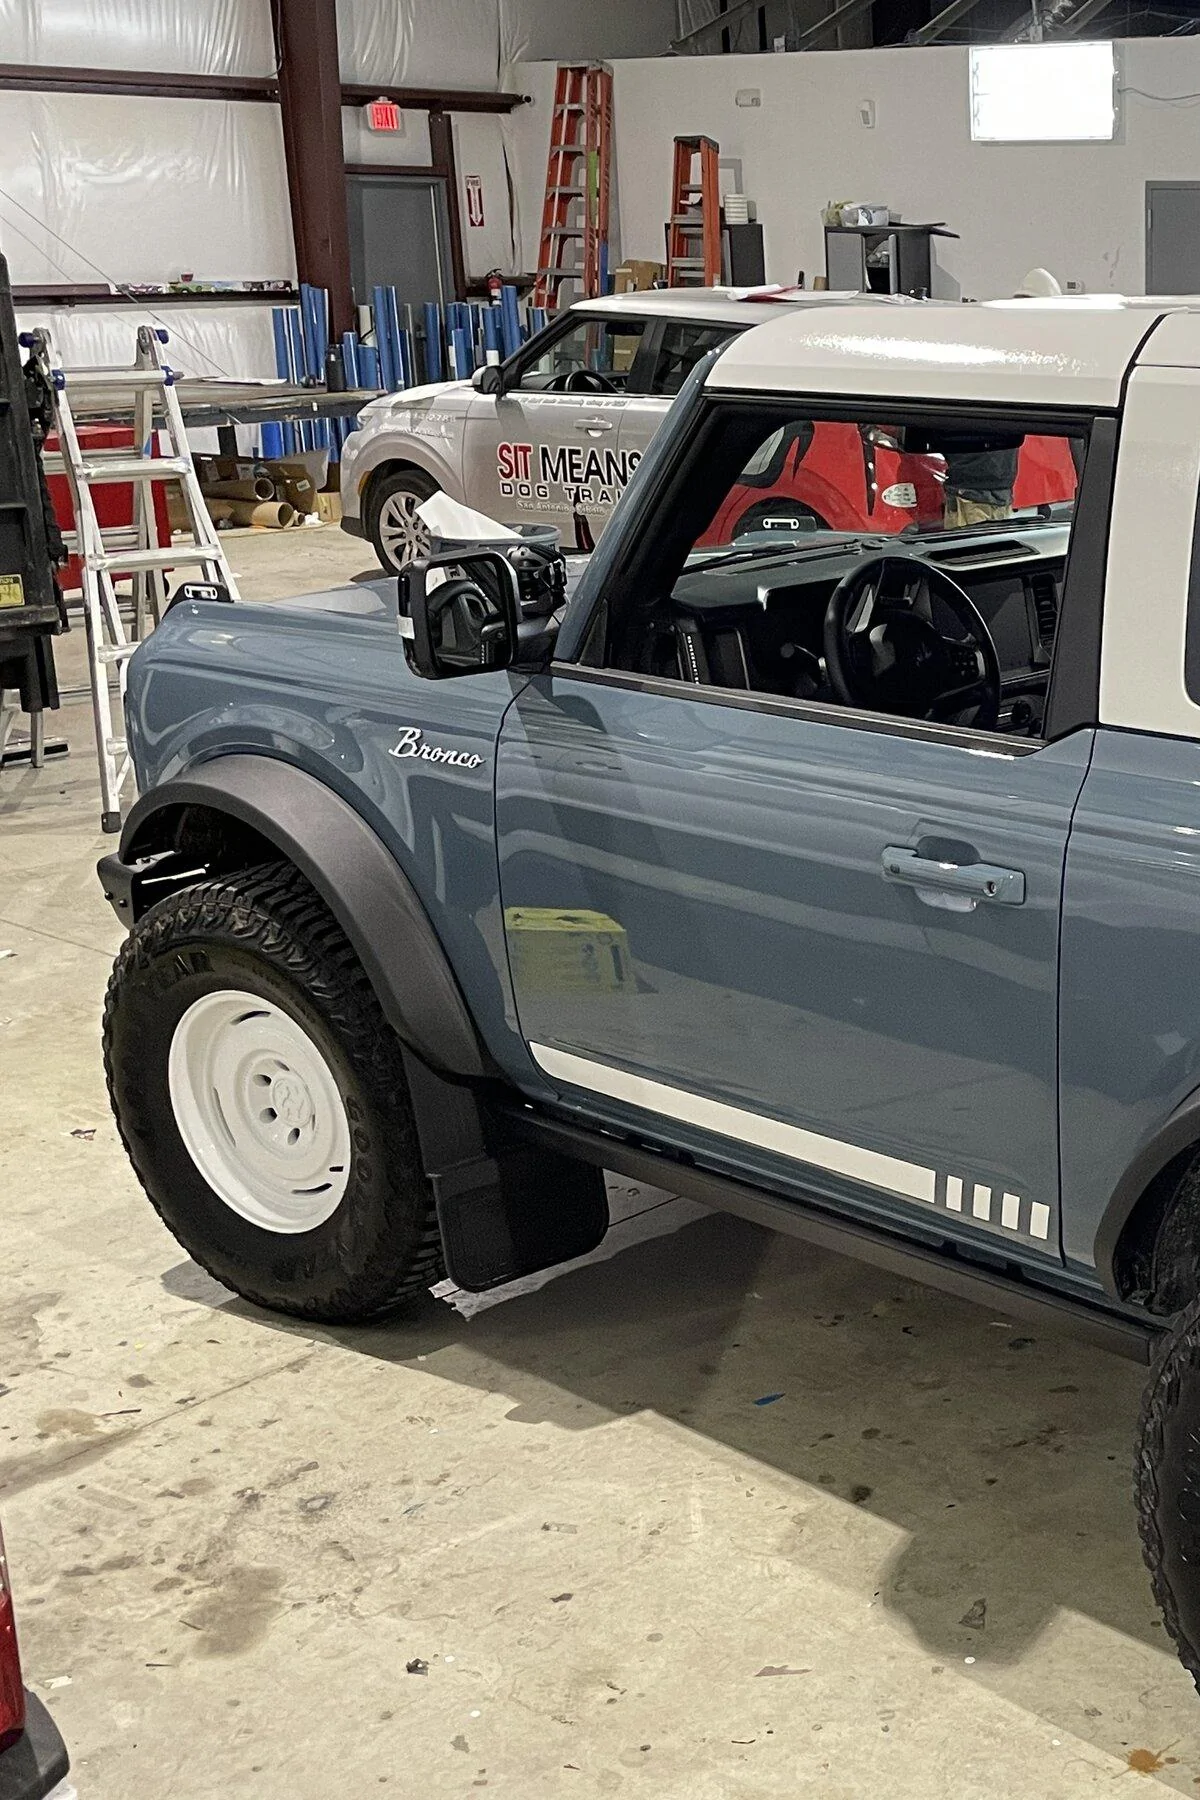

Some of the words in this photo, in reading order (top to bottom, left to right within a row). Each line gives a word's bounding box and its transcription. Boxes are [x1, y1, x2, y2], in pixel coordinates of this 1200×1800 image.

[375, 106, 397, 129] EXIT
[498, 442, 532, 482] SIT
[501, 482, 549, 498] DOG
[388, 726, 486, 769] Bronco
